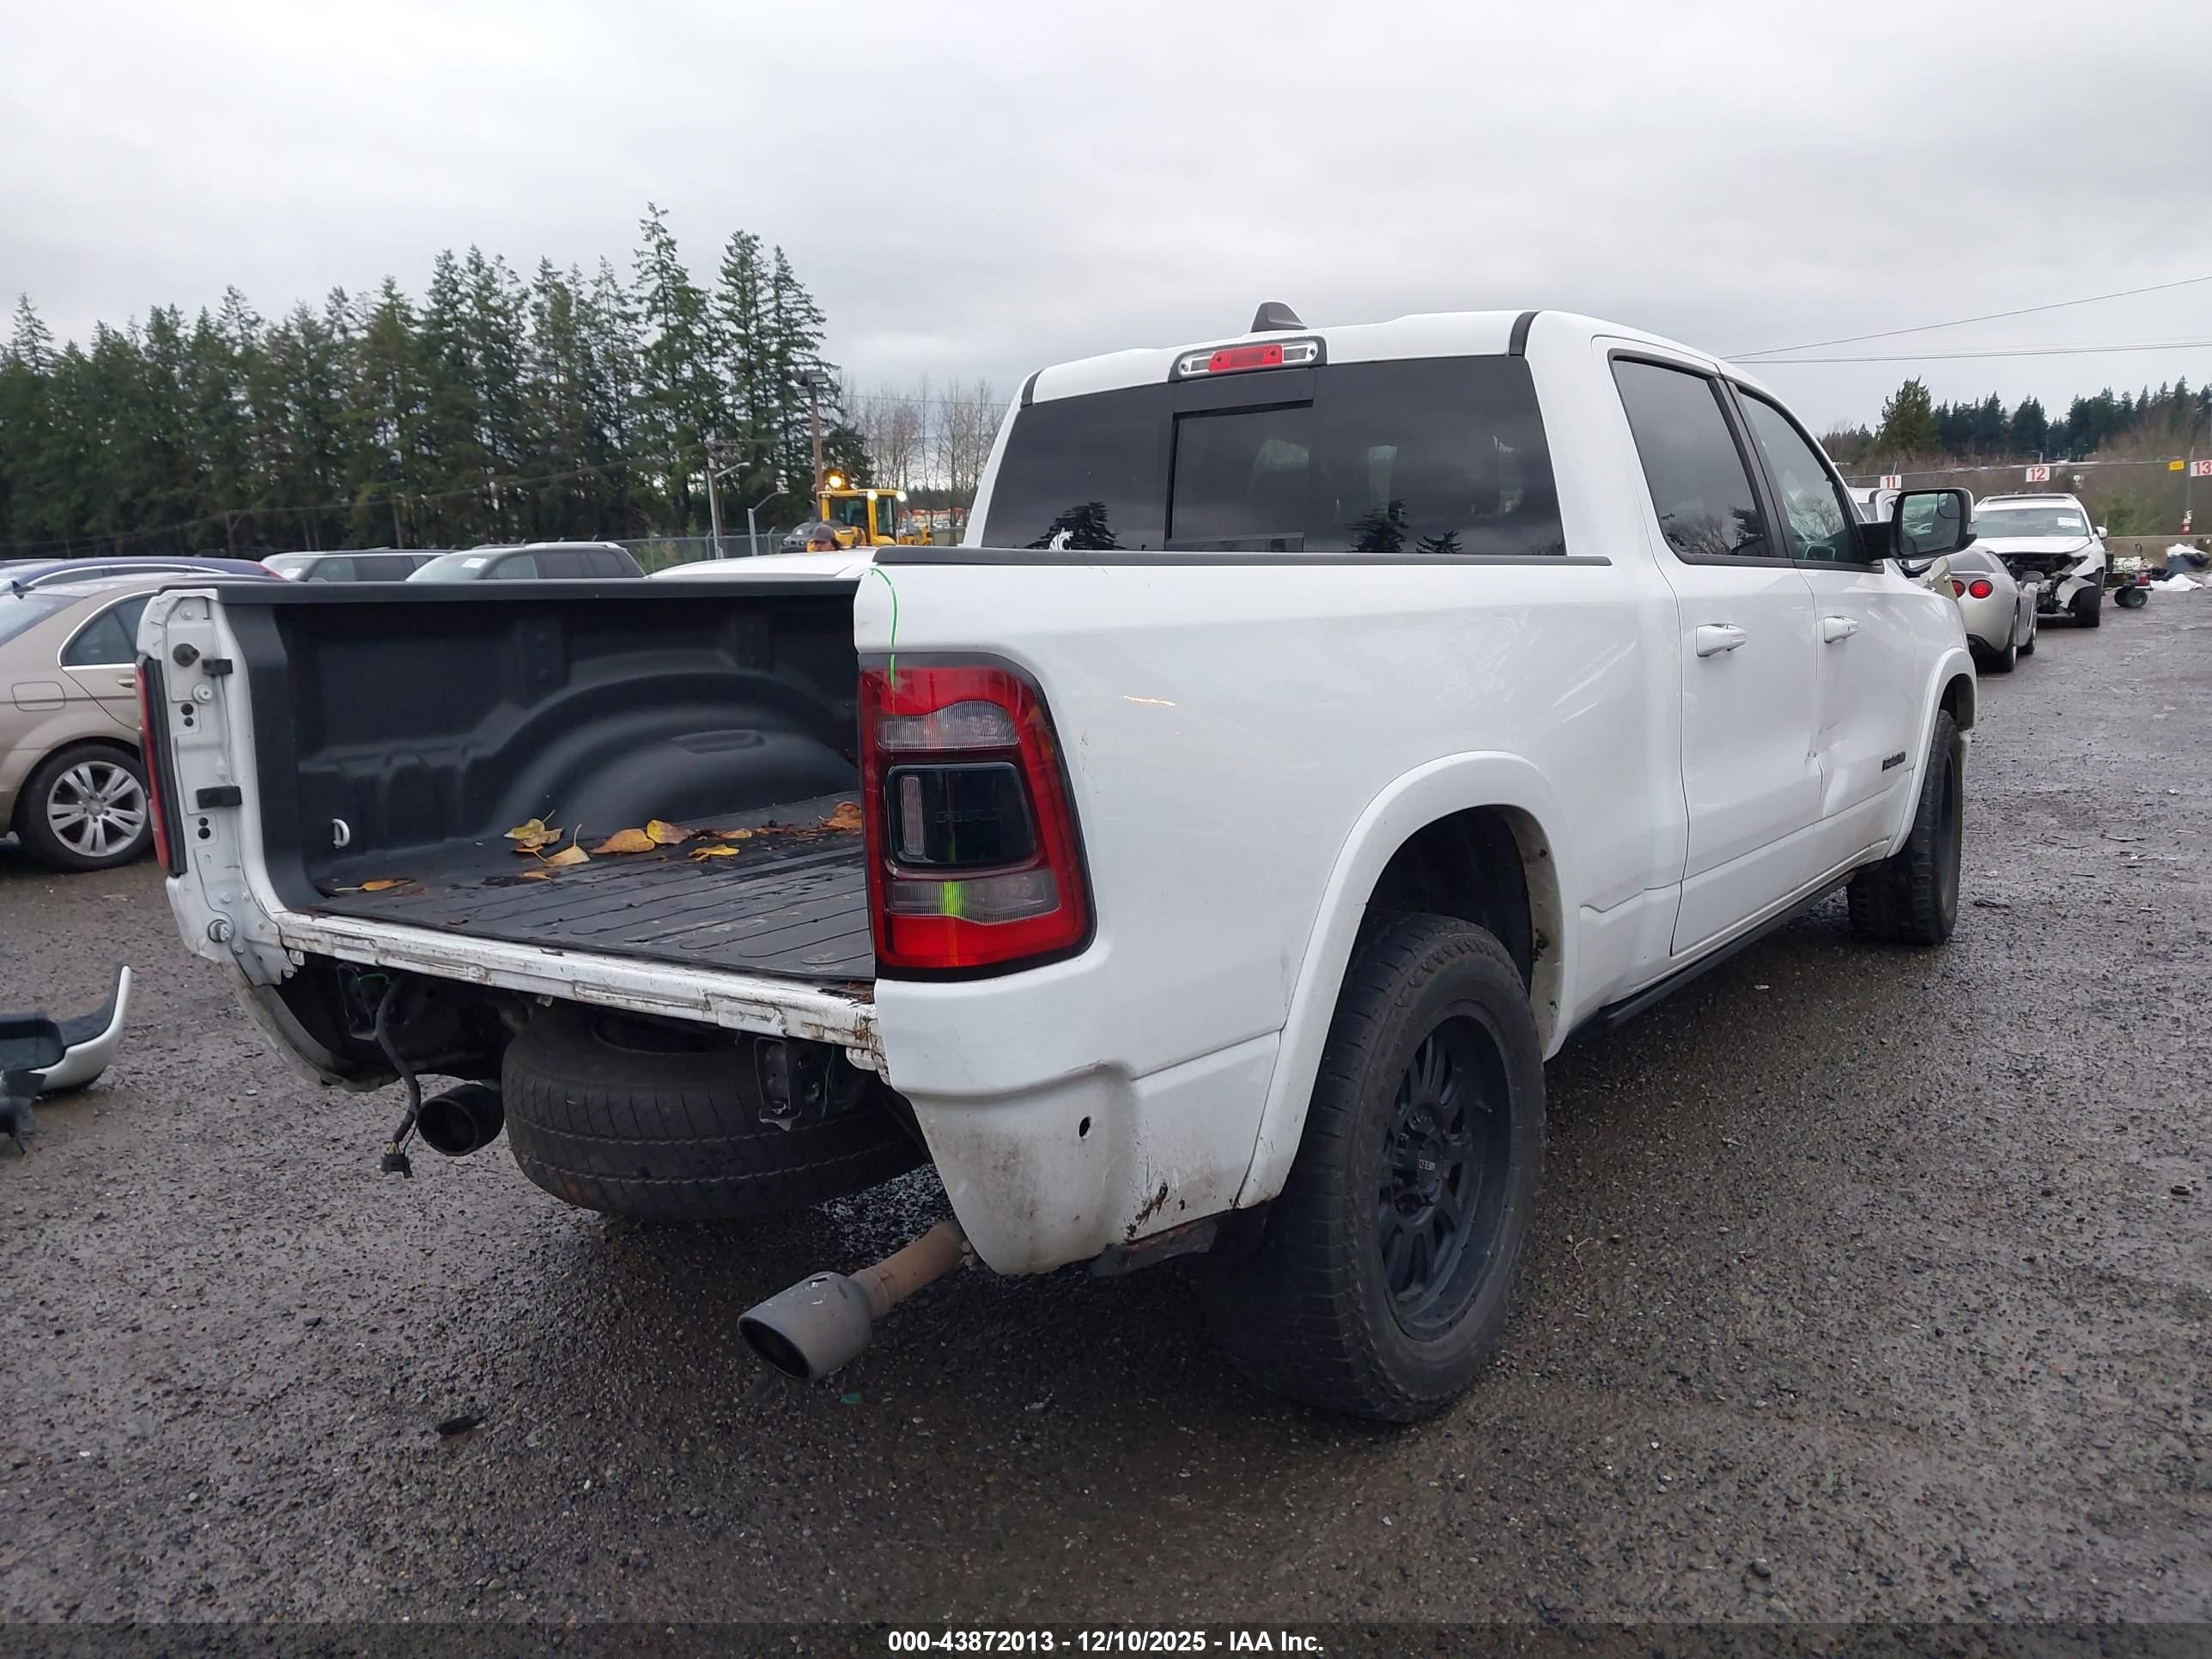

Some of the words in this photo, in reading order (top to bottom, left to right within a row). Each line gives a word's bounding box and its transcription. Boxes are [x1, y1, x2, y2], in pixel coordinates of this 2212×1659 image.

[2030, 467, 2045, 481] 12
[2195, 460, 2212, 475] 13
[1885, 476, 1896, 489] 11
